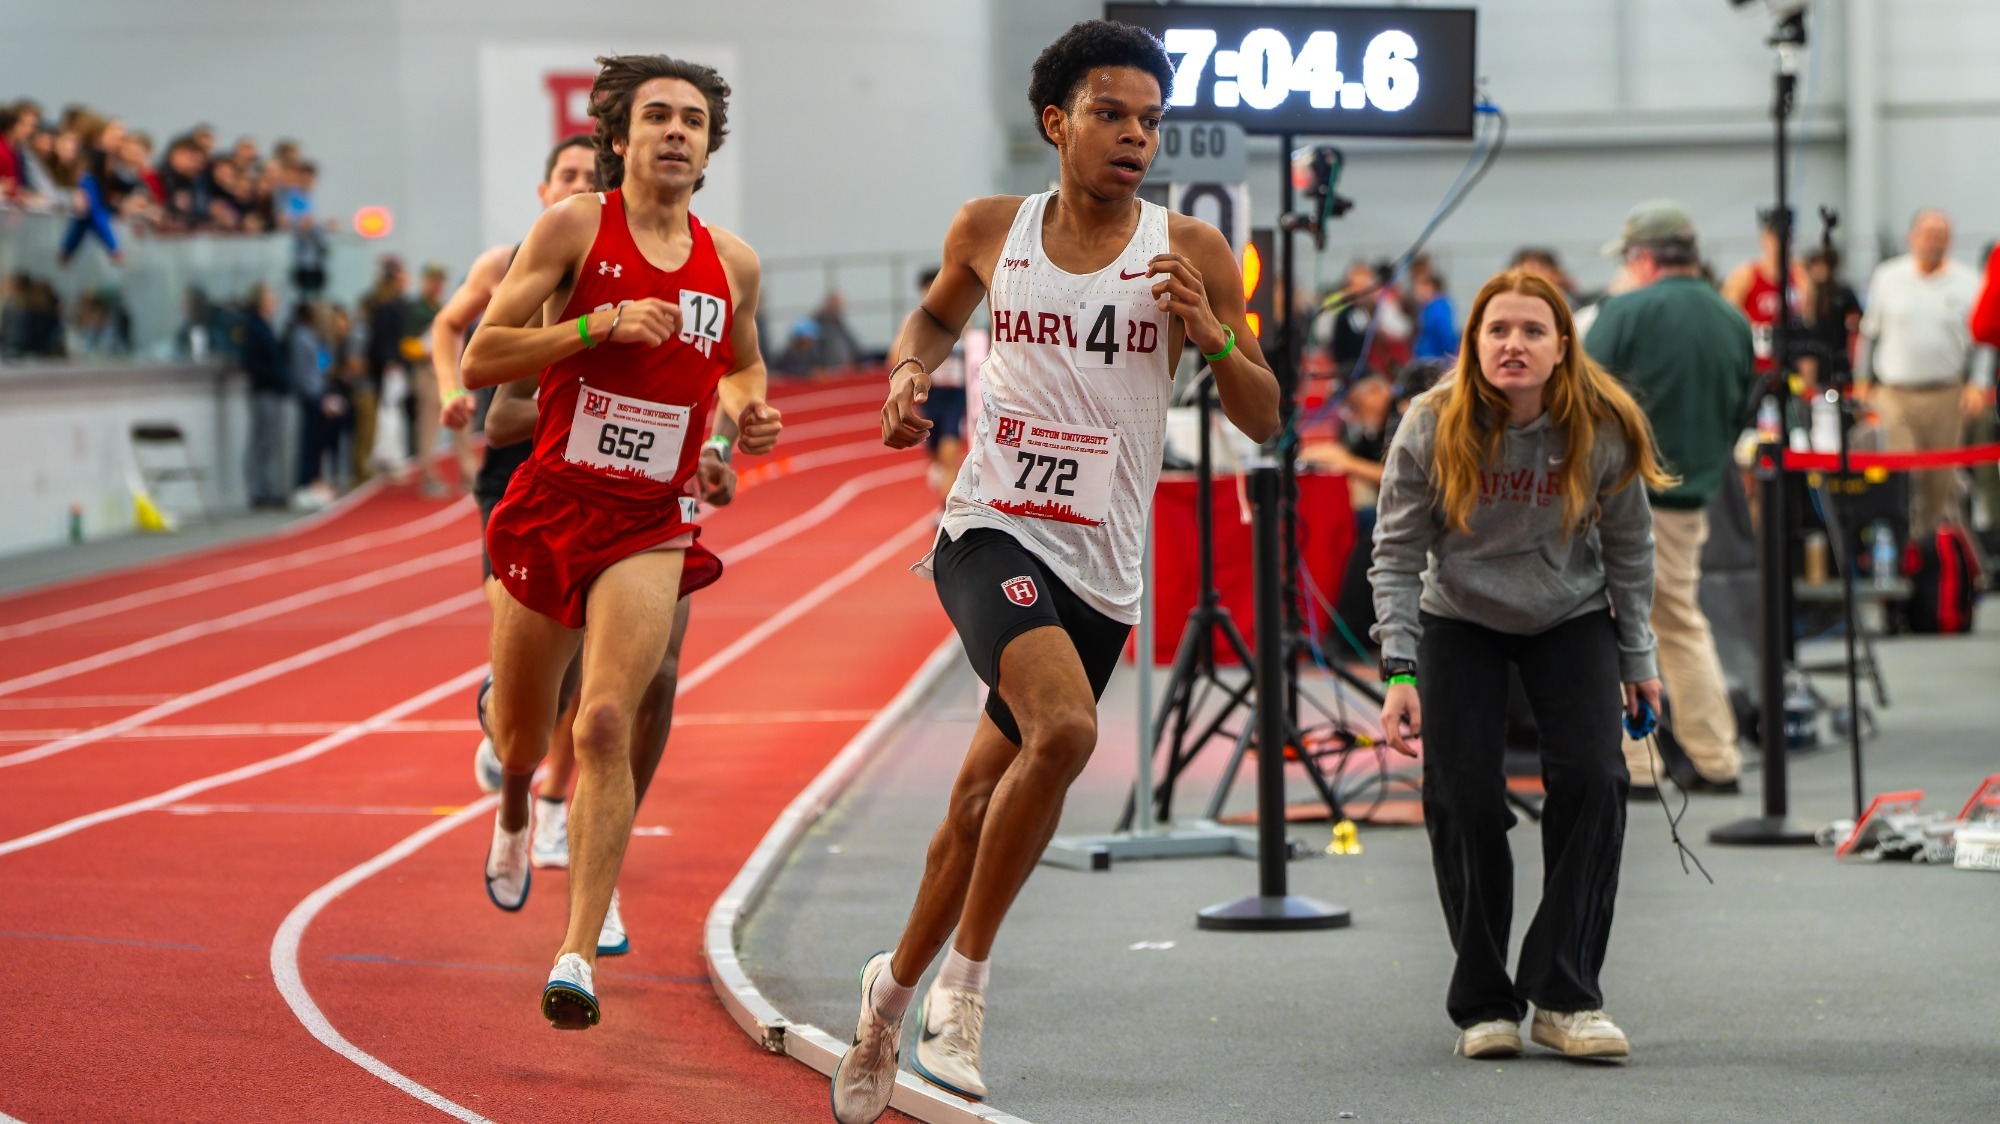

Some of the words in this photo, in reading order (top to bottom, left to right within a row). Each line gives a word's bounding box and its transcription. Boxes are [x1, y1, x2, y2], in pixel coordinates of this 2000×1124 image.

[1165, 28, 1420, 111] 7:04.6
[1189, 126, 1226, 158] GO
[690, 295, 717, 338] 12
[994, 310, 1158, 354] HARVRD
[1086, 304, 1120, 365] 4
[584, 391, 612, 416] BU
[617, 403, 642, 415] BOSTON
[643, 409, 681, 421] UNIVERSITY
[597, 423, 656, 464] 652
[996, 416, 1026, 443] BU
[1031, 427, 1060, 440] BOSTON
[1061, 432, 1109, 446] UNIVERSITY
[1014, 450, 1079, 497] 772
[1010, 582, 1034, 601] H
